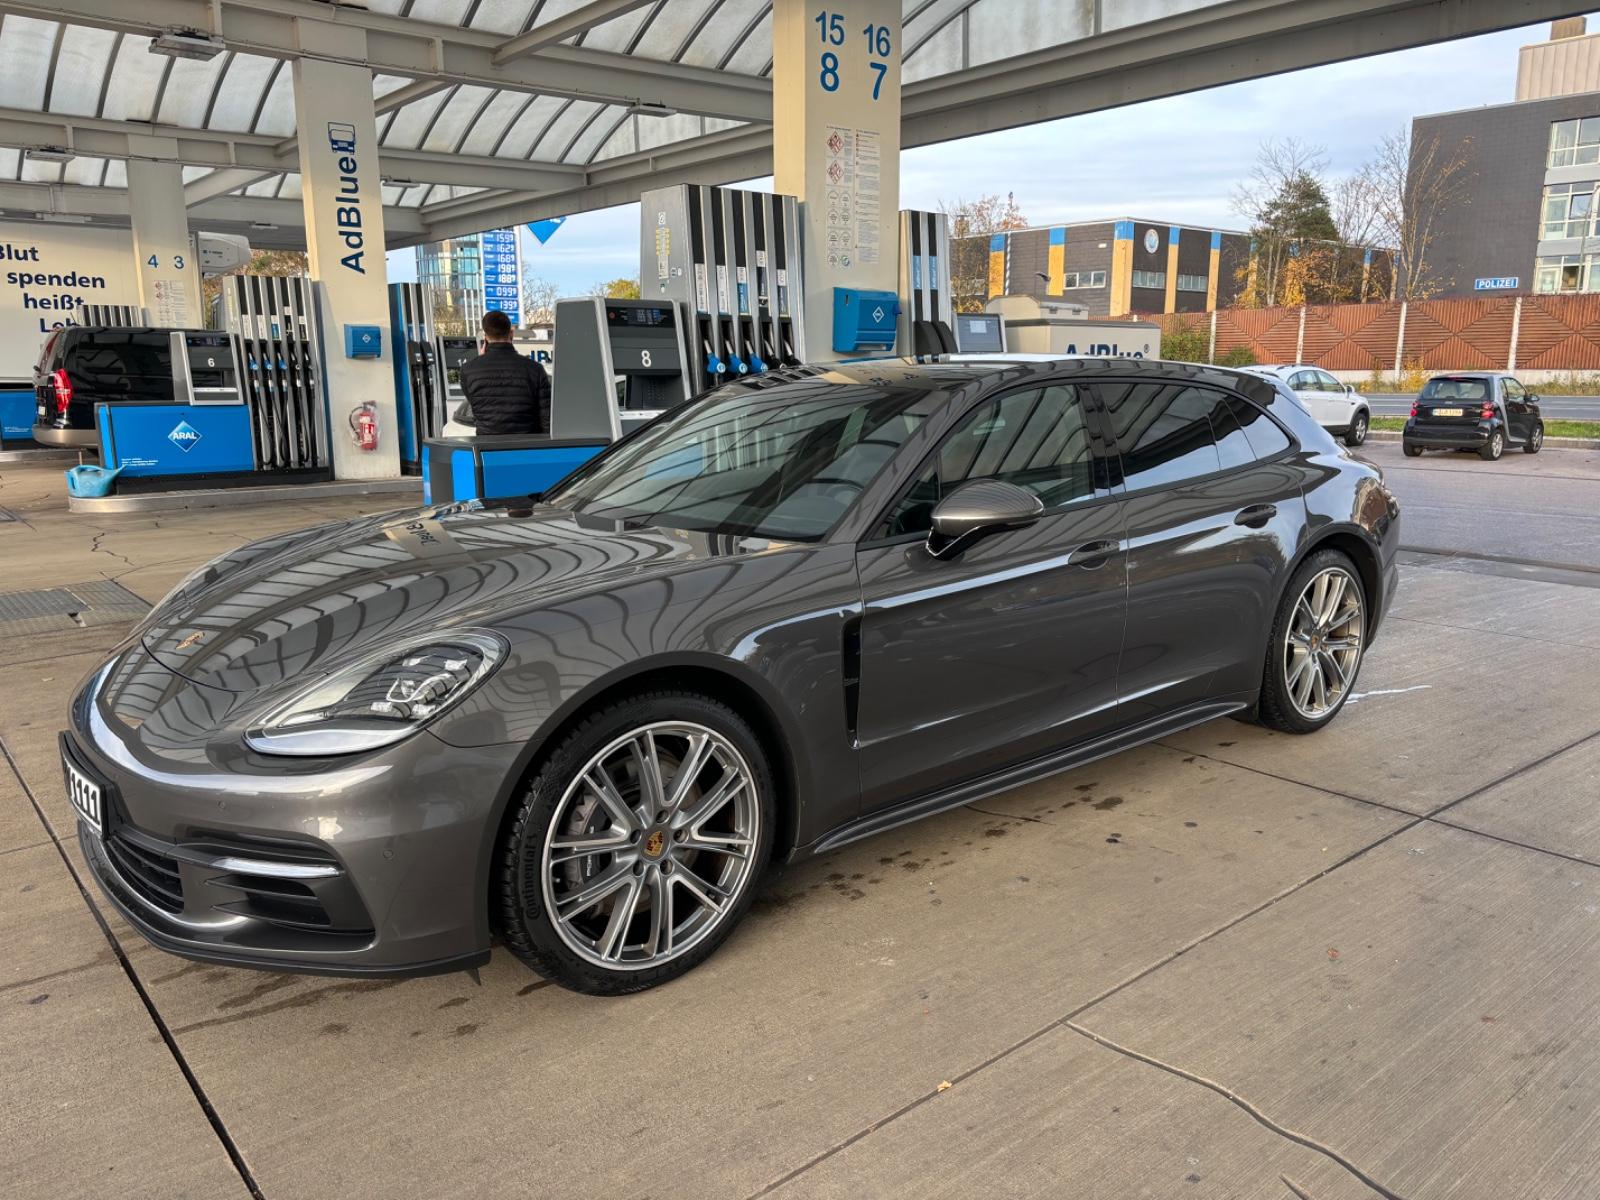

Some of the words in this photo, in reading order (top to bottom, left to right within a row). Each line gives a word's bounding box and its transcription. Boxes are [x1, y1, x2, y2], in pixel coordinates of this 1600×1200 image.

[815, 10, 845, 46] 15
[863, 23, 891, 58] 16
[820, 52, 840, 92] 8
[869, 61, 887, 100] 7
[335, 155, 366, 275] AdBlue
[147, 254, 159, 269] 4
[174, 255, 185, 270] 3
[7, 271, 105, 289] spenden
[1478, 279, 1515, 289] POLIZEI
[23, 293, 85, 310] heißt
[207, 357, 215, 367] 6
[641, 350, 652, 368] 8
[172, 432, 198, 441] ARAL
[522, 842, 541, 920] Continental
